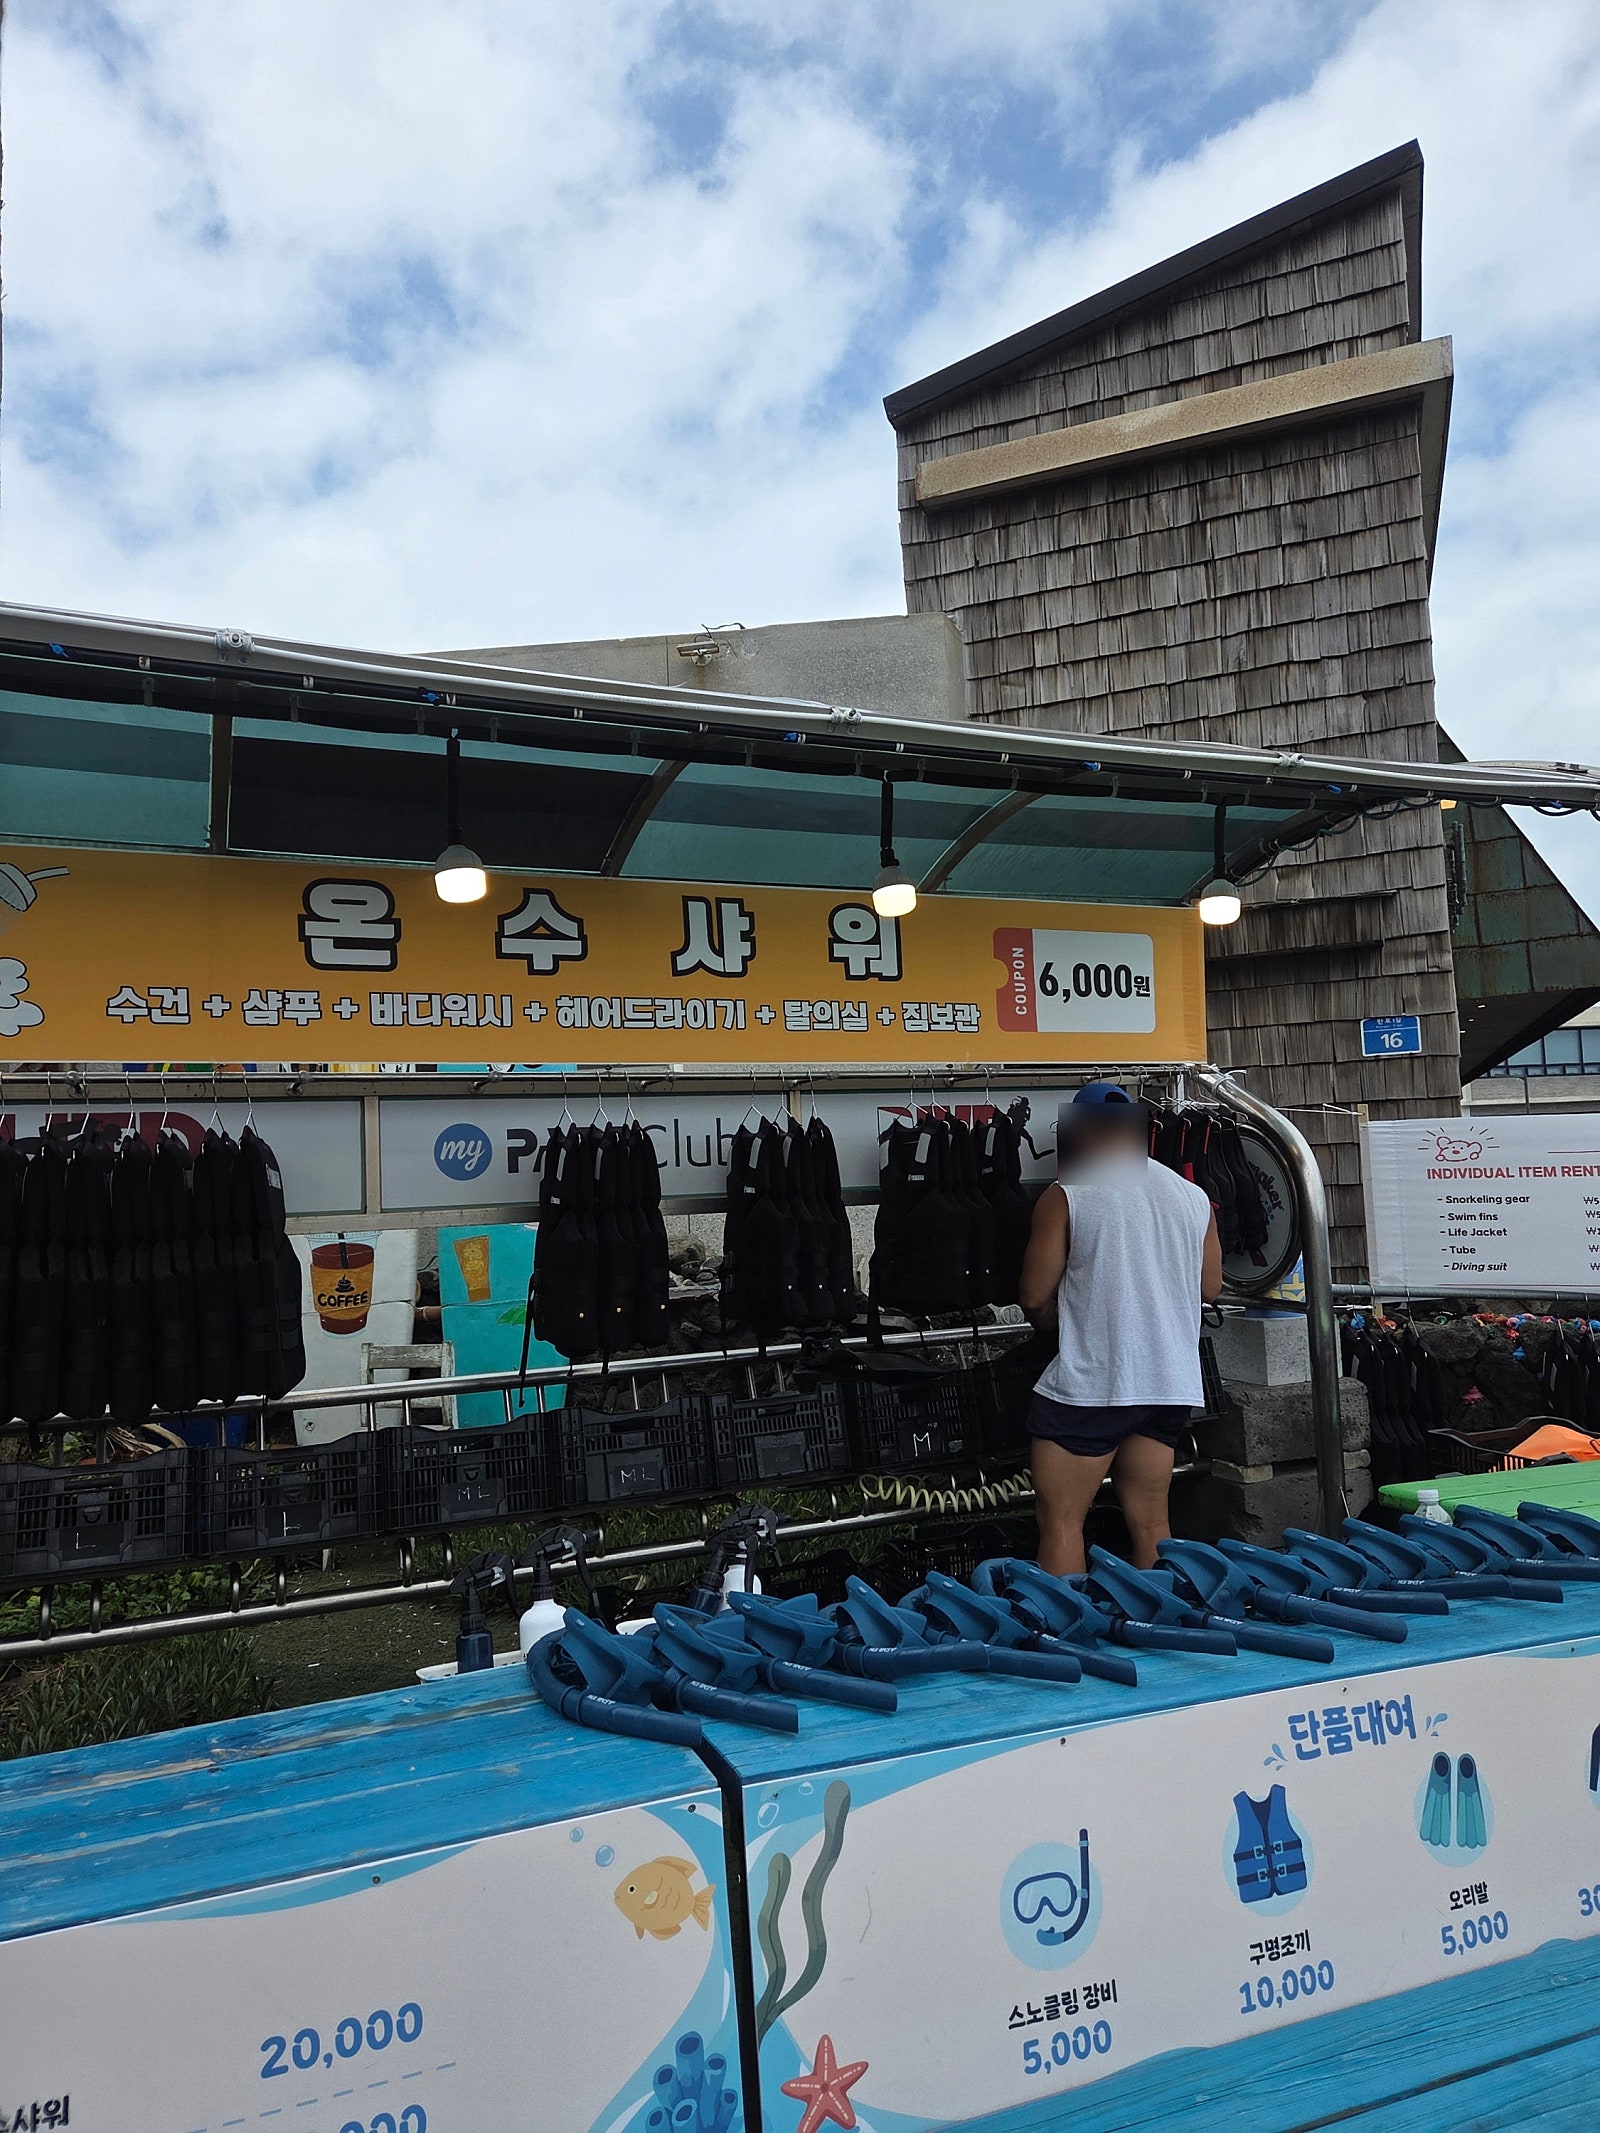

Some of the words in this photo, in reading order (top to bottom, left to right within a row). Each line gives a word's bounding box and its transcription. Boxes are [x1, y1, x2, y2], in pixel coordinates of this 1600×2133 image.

[298, 877, 402, 972] 온
[495, 887, 588, 976] 수
[670, 895, 756, 977] 샤
[1012, 947, 1027, 1015] COUPON
[1039, 961, 1151, 1004] 6,000원
[106, 986, 191, 1024] 수건
[241, 990, 322, 1026] 샴푸
[370, 992, 513, 1027] 바디워시
[555, 995, 747, 1031] 헤어드라이기
[783, 1000, 869, 1032] 탈의실
[901, 1001, 981, 1033] 짐보관
[1380, 1032, 1404, 1049] 16
[439, 1137, 487, 1171] my
[1427, 1167, 1515, 1180] INDIVIDUAL
[1518, 1166, 1557, 1178] ITEM
[1445, 1195, 1503, 1205] Snorkeling
[1505, 1196, 1530, 1205] gear
[1447, 1213, 1477, 1221] Swim
[1478, 1212, 1499, 1221] fins
[1448, 1228, 1468, 1236] Life
[1470, 1228, 1508, 1237] Jacket
[1449, 1246, 1477, 1254] Tube
[1451, 1262, 1485, 1272] Diving
[1487, 1262, 1508, 1271] suit
[317, 1291, 368, 1308] COFFEE
[1287, 1694, 1417, 1761] 단품대여
[1449, 1881, 1489, 1911] 오리발
[1249, 1928, 1311, 1966] 구명조끼
[1441, 1910, 1509, 1955] 5,000
[1008, 1988, 1079, 2030] 스노클링
[1082, 1978, 1118, 2010] 장비
[1239, 1960, 1334, 2014] 10,000
[260, 2002, 423, 2079] 20,000
[1023, 2019, 1112, 2075] 5,000
